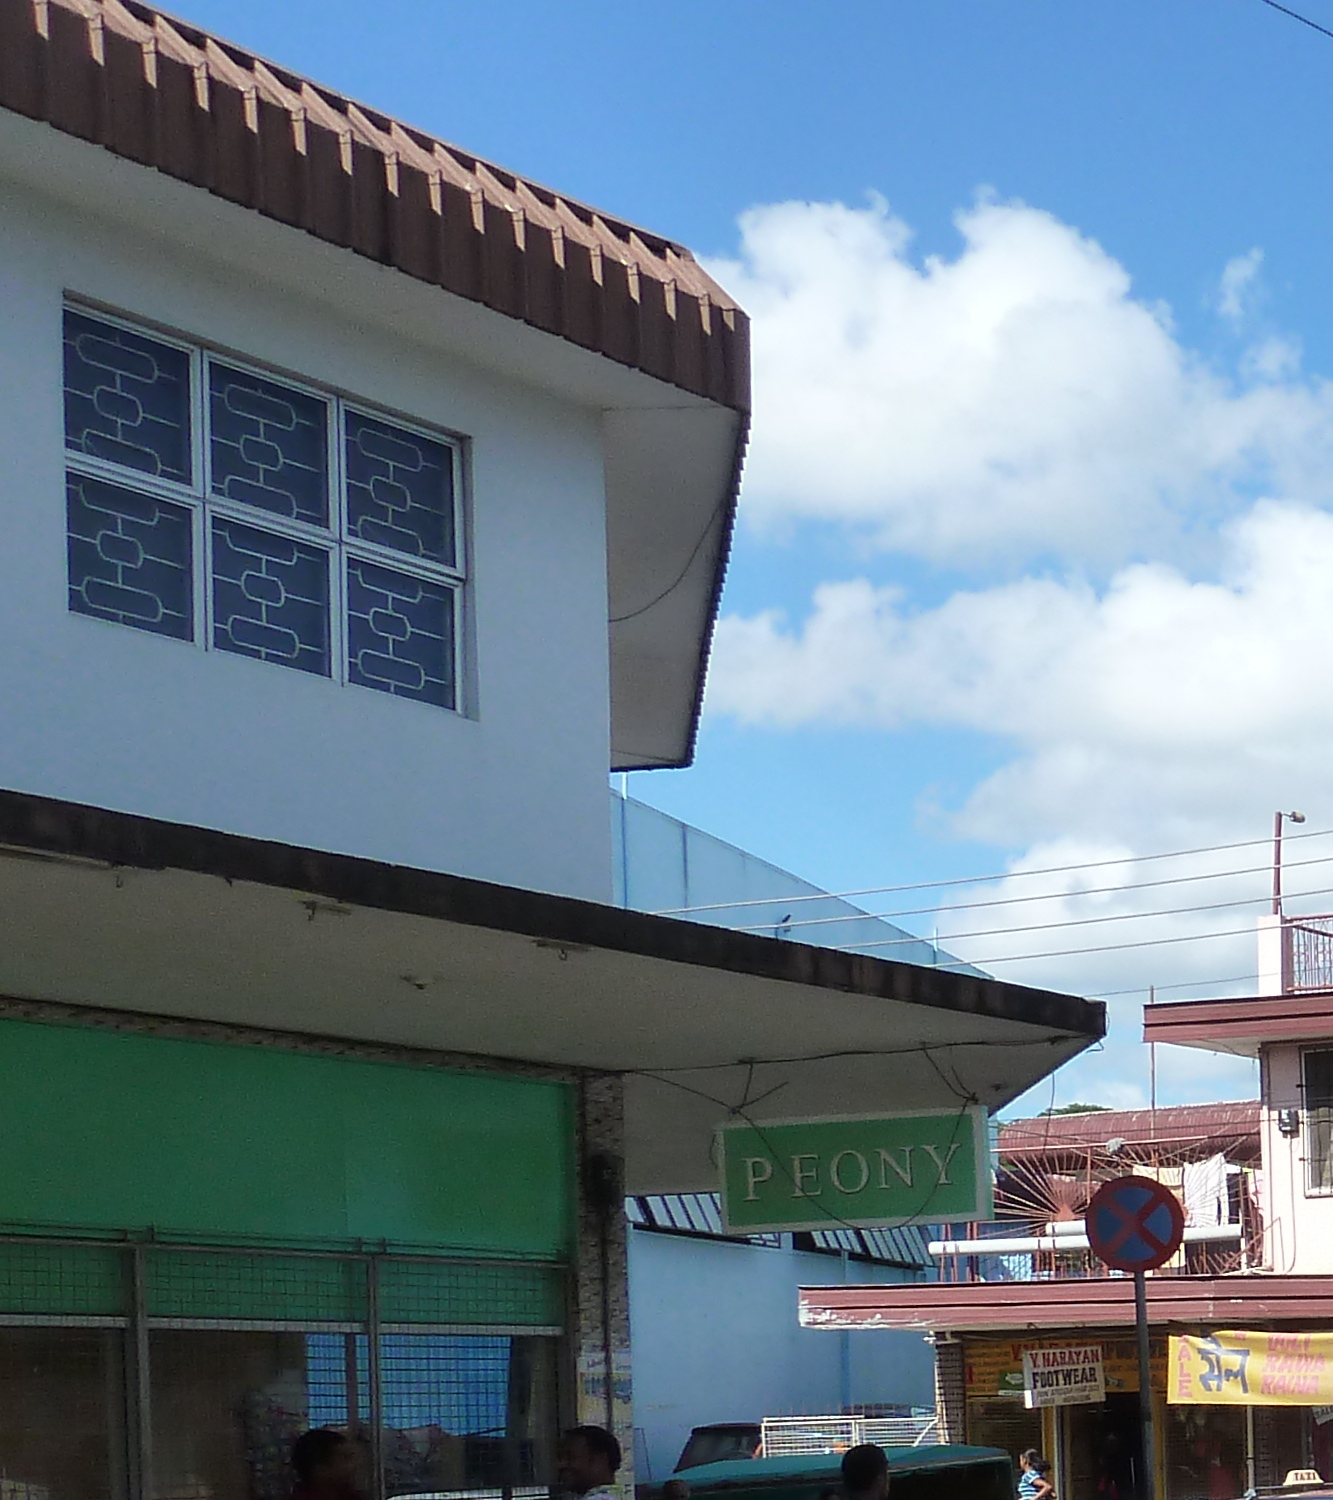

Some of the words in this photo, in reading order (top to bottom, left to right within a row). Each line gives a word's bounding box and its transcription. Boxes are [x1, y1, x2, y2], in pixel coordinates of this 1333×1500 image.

[740, 1142, 963, 1202] PEONY
[1042, 1348, 1101, 1369] NARAYAN
[1031, 1367, 1099, 1391] FOOTWEAR
[1293, 1471, 1317, 1482] TAXI
